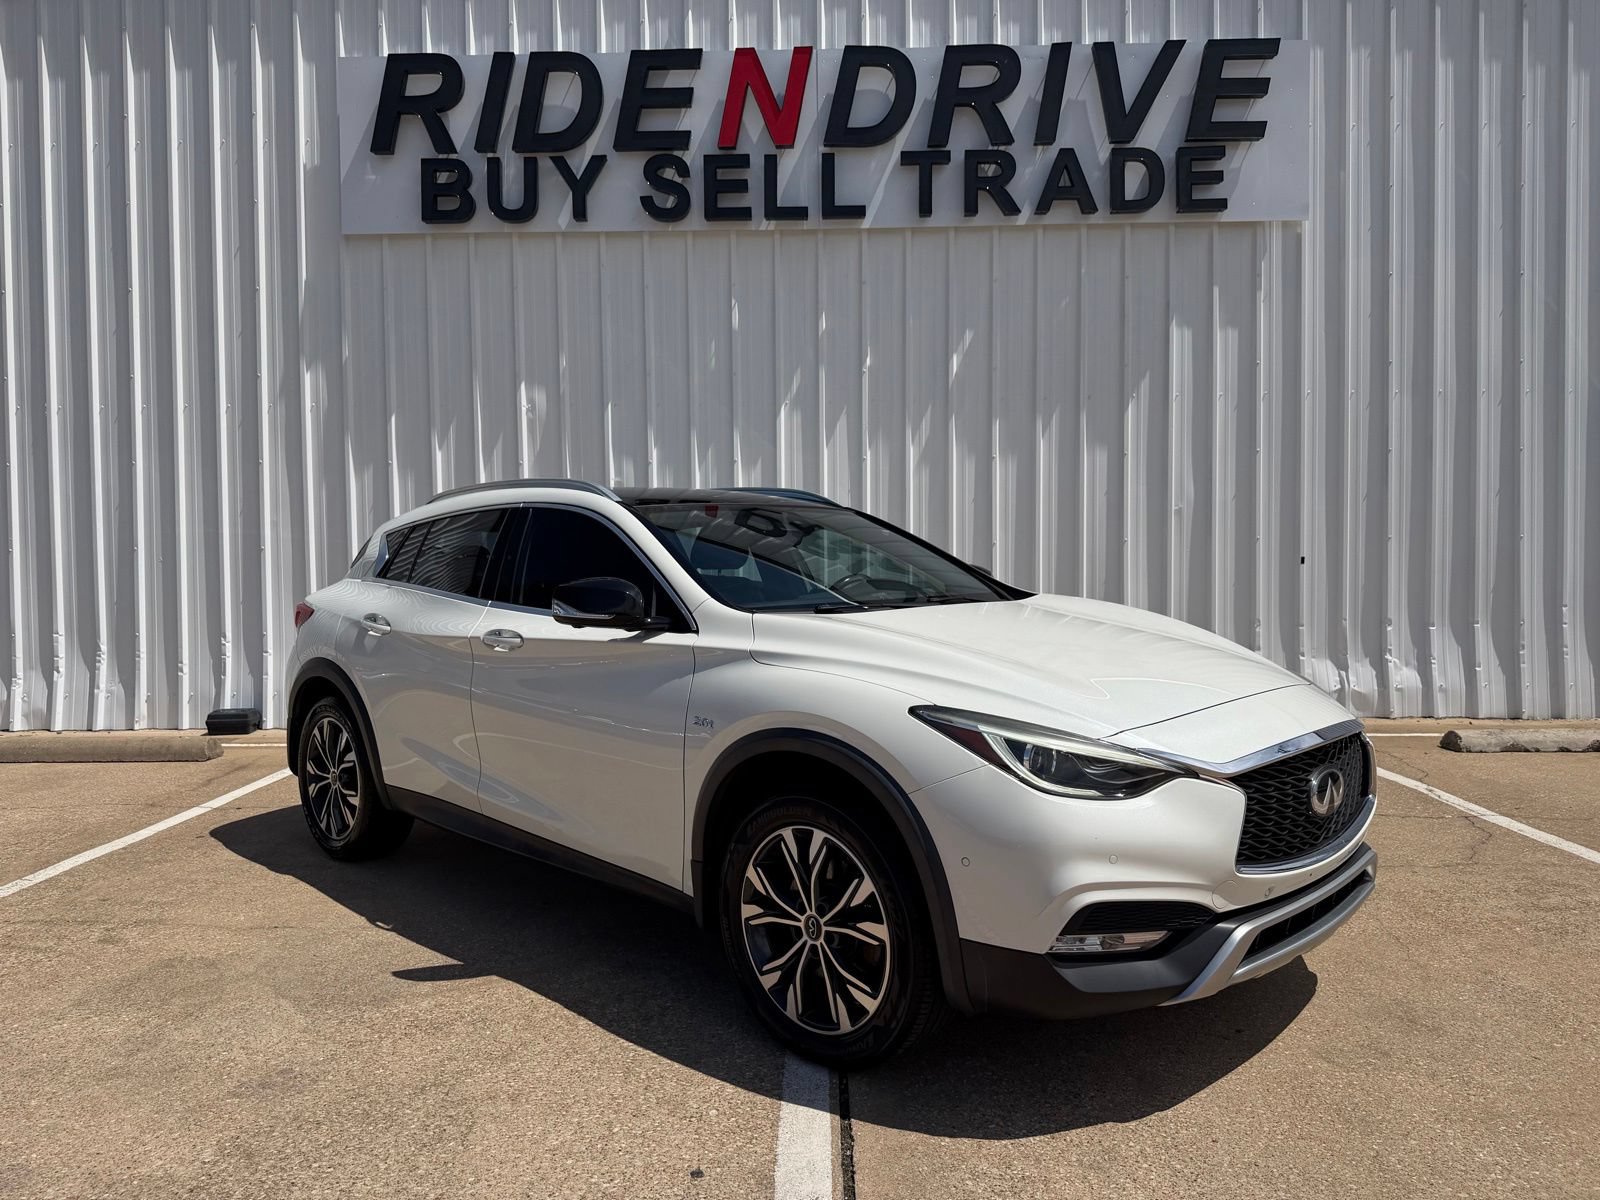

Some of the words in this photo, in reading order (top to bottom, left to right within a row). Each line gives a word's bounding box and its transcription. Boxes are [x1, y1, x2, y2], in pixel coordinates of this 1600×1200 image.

[420, 154, 607, 224] BUY
[640, 152, 866, 222] SELL
[900, 145, 1228, 217] TRADE
